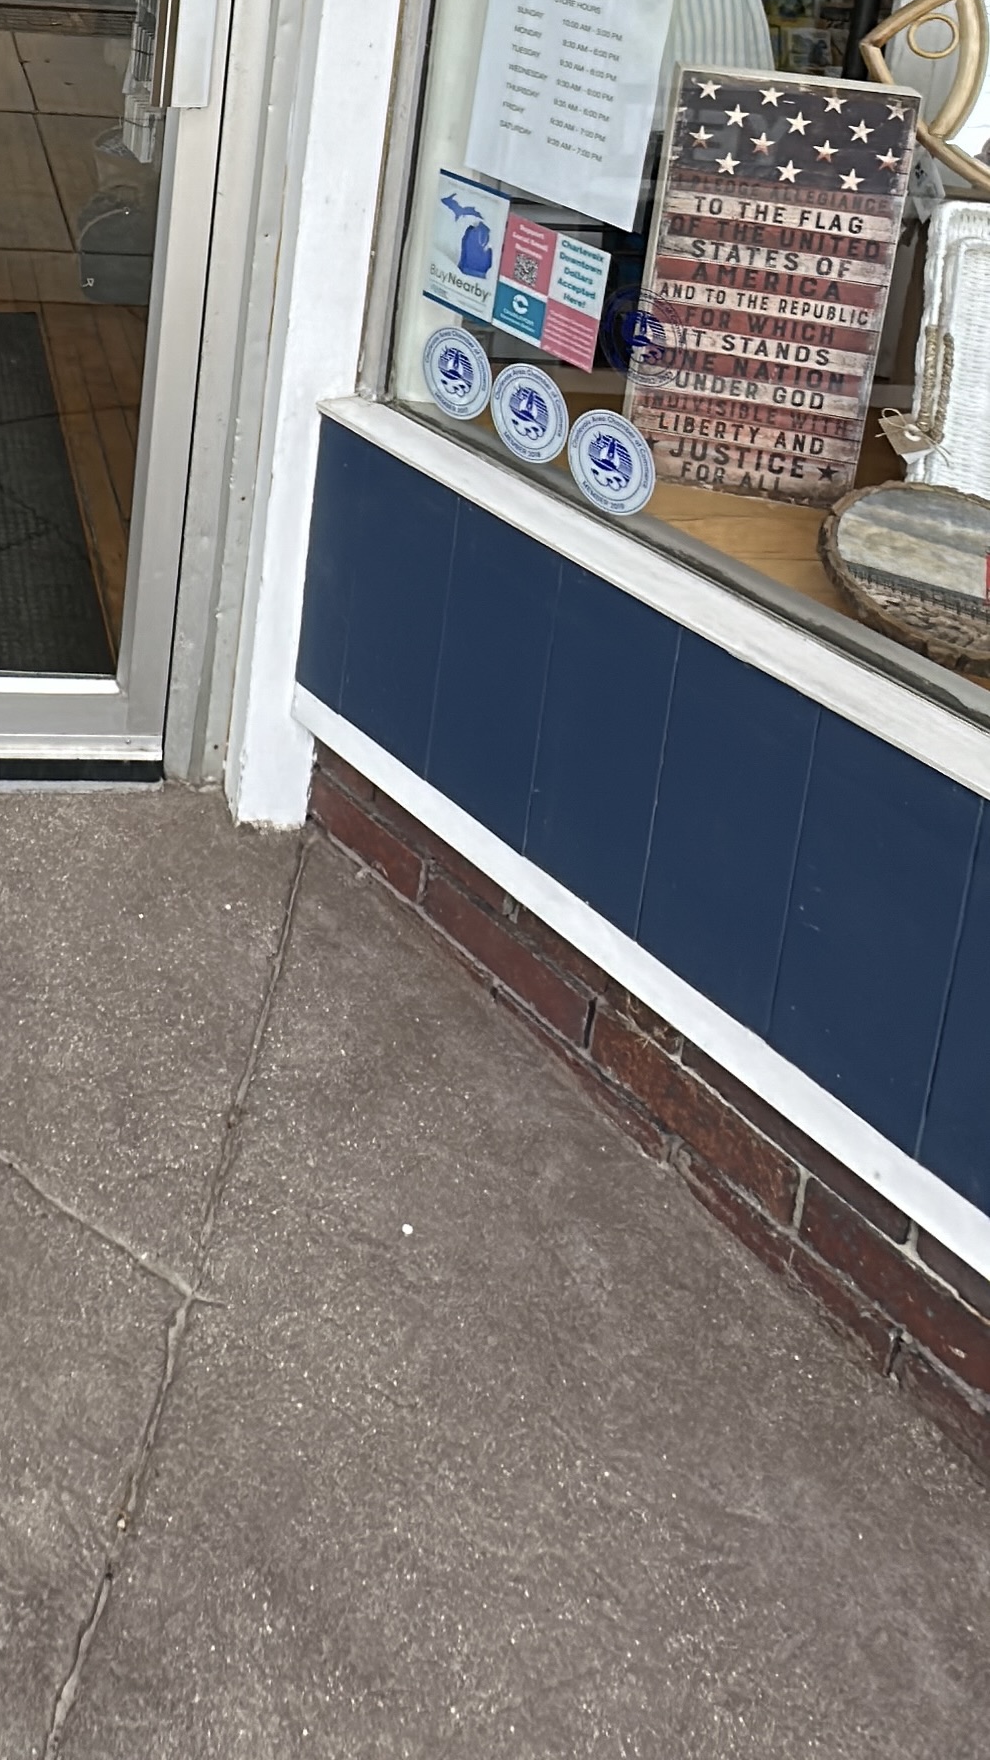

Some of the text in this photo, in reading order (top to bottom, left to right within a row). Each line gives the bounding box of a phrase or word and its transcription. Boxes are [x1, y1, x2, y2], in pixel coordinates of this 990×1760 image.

[517, 5, 545, 19] SUNDAY
[577, 1, 601, 15] HOURS
[514, 25, 542, 39] MONDAY
[512, 43, 540, 58] TUESDAY
[508, 63, 548, 81] WEDNESDAY
[506, 82, 540, 98] THURSDAY
[502, 101, 525, 114] FRIDAY
[499, 119, 532, 136] SATURDAY
[687, 175, 762, 199] PLEDGE
[770, 187, 892, 214] ALLEGIANCE
[694, 195, 864, 235] TO THE FLAG
[561, 239, 605, 263] Charlevoix
[669, 215, 881, 260] OF THE UNITED
[559, 251, 602, 276] Downtown
[691, 239, 852, 279] STATES OF
[557, 277, 597, 300] Accepted
[564, 266, 594, 286] Dollars
[692, 264, 841, 302] AMERICA
[563, 292, 587, 309] Here!
[660, 281, 870, 326] AND TO THE REPUBLIC
[685, 306, 731, 329] FOR
[747, 315, 834, 345] WHICH
[679, 328, 831, 367] IT STANDS
[662, 349, 845, 391] ONE NATION
[675, 372, 758, 400] UNDER
[772, 387, 825, 410] GOD
[644, 392, 848, 436] INDIVISIBLE WITH
[659, 413, 825, 455] LIBERTY AND
[669, 439, 806, 479] JUSTICE
[681, 461, 781, 491] FOR ALL
[582, 480, 609, 506] MEMBER
